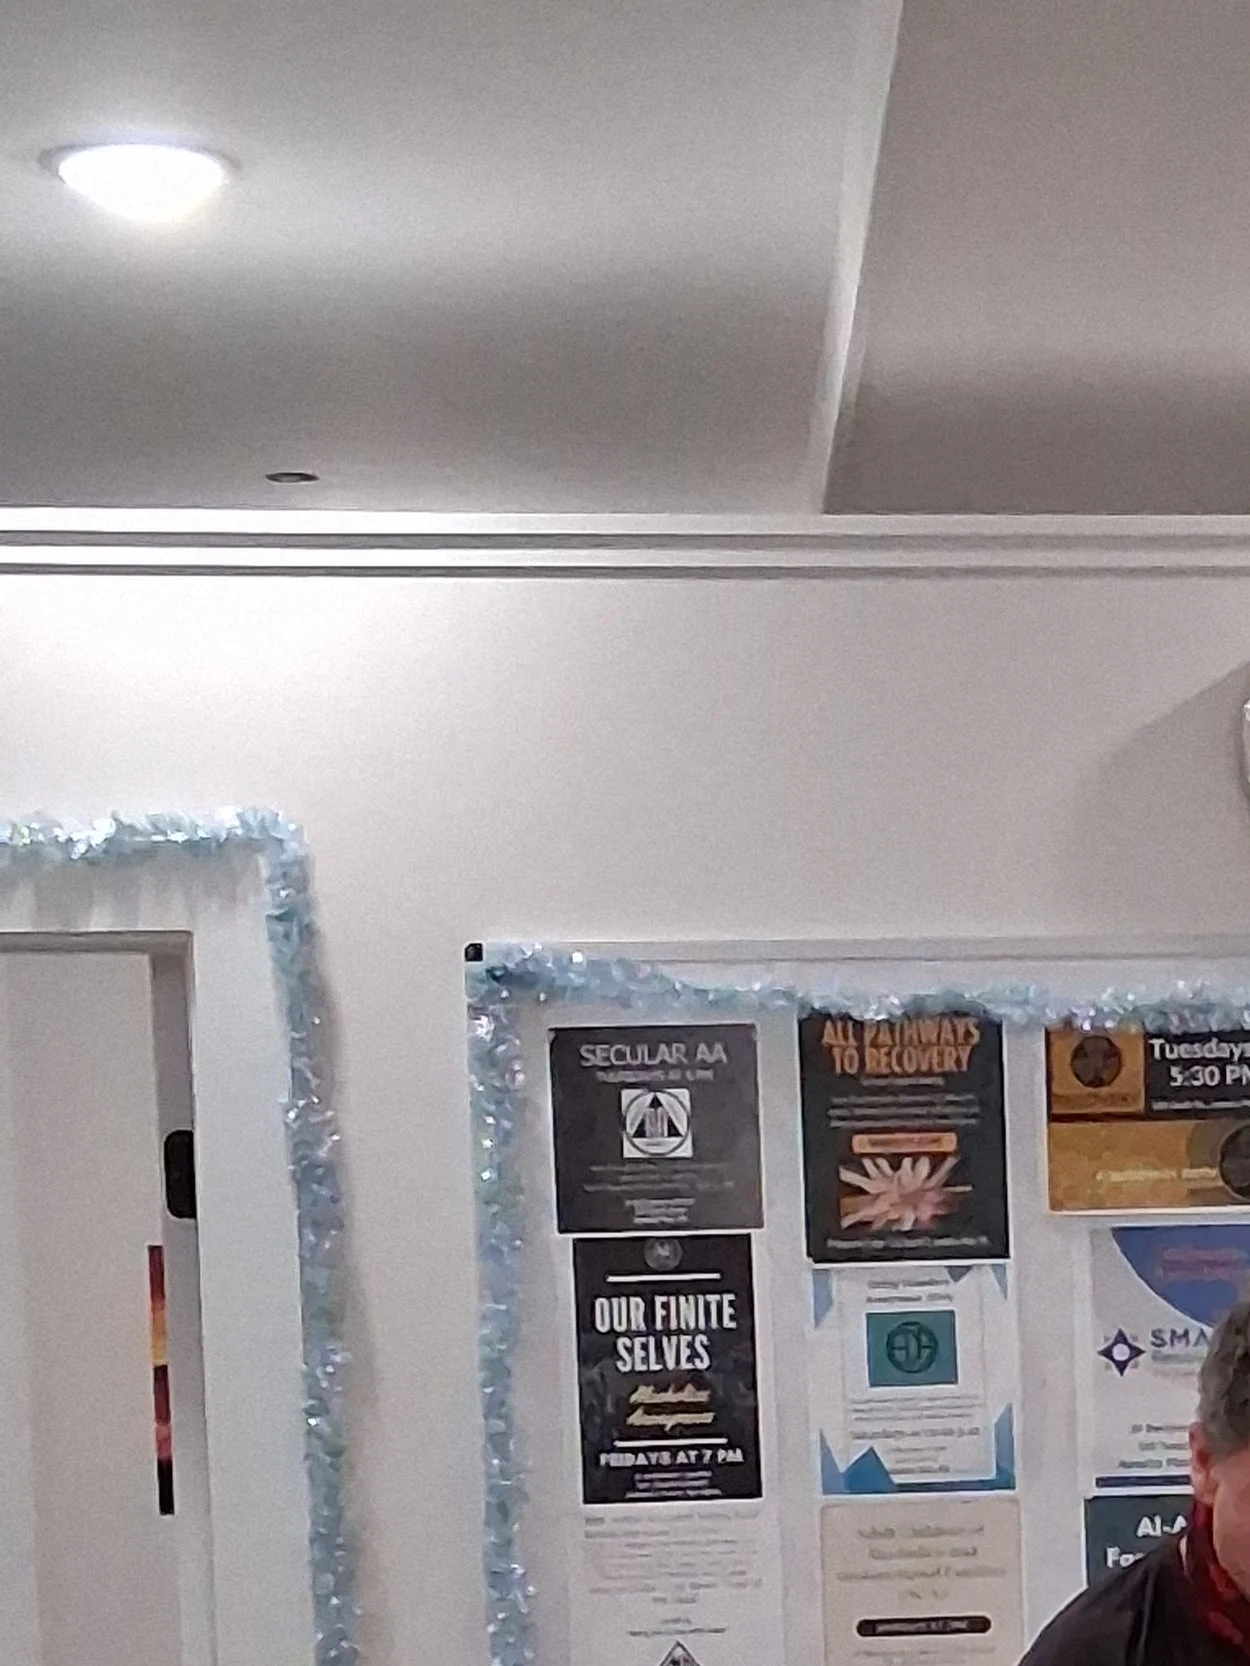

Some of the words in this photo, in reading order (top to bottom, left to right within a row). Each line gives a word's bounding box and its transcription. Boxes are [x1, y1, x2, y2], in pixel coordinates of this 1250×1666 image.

[822, 1019, 857, 1046] ALL
[864, 1016, 980, 1046] PATHWAYS
[580, 1042, 690, 1067] SECULAR
[696, 1042, 728, 1065] AA
[832, 1047, 860, 1074] TO
[865, 1045, 972, 1074] RECOVERY
[1170, 1065, 1221, 1086] 5:30
[595, 1296, 646, 1333] OUR
[655, 1293, 737, 1331] FINITE
[616, 1334, 711, 1373] SELVES
[675, 1449, 699, 1463] AT
[702, 1449, 712, 1464] 7
[717, 1448, 745, 1463] PM
